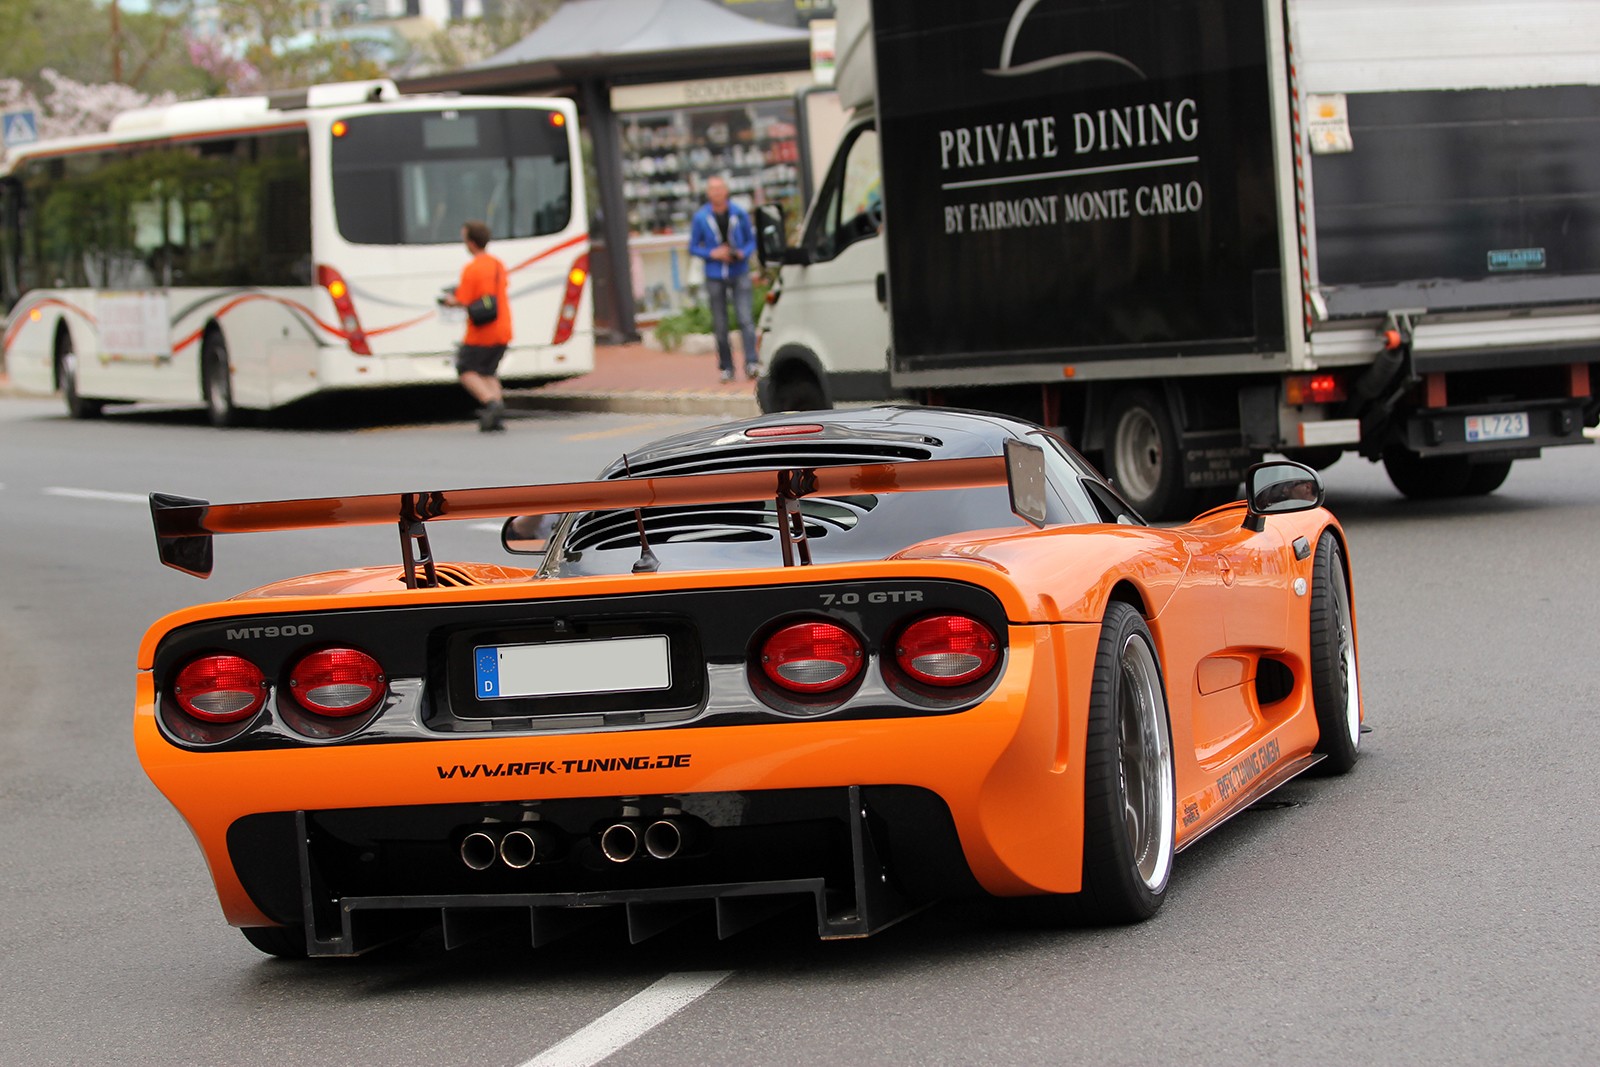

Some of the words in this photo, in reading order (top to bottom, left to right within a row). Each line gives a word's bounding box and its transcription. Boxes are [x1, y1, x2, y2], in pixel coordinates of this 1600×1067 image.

[684, 78, 786, 101] SOUVENIRS
[940, 117, 1058, 169] PRIVATE
[1073, 98, 1200, 154] DINING
[945, 205, 964, 234] BY
[970, 196, 1058, 232] FAIRMONT
[1064, 188, 1131, 223] MONTE
[1135, 181, 1203, 216] CARLO
[1481, 414, 1523, 434] L723
[820, 593, 859, 606] 7.0
[868, 591, 923, 604] GTR
[227, 624, 314, 640] MT900
[484, 680, 493, 692] D
[437, 754, 692, 779] WWW.RFK-TUNING.DE
